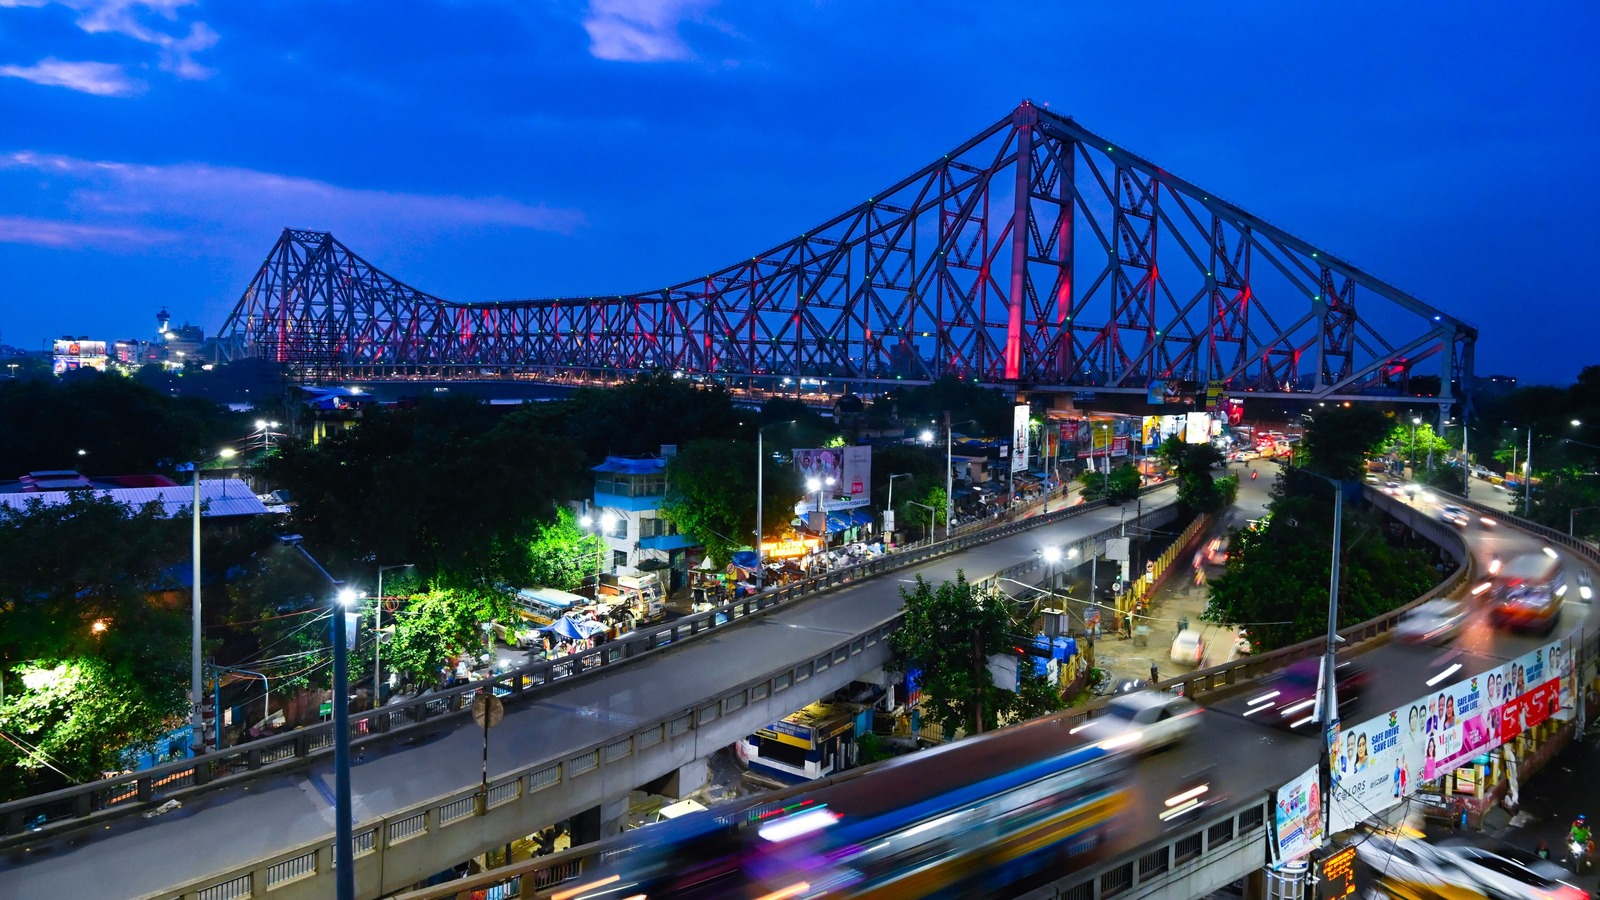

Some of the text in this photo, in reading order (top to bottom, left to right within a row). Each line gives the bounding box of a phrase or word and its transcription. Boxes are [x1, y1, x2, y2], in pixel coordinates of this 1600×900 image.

[1457, 691, 1480, 707] SAFE DRIVE
[1459, 700, 1478, 715] SAVE LIFE
[1372, 725, 1399, 745] SAFE DRIVE
[1374, 736, 1397, 754] SAVE LIFE
[1336, 780, 1366, 802] COLORS
